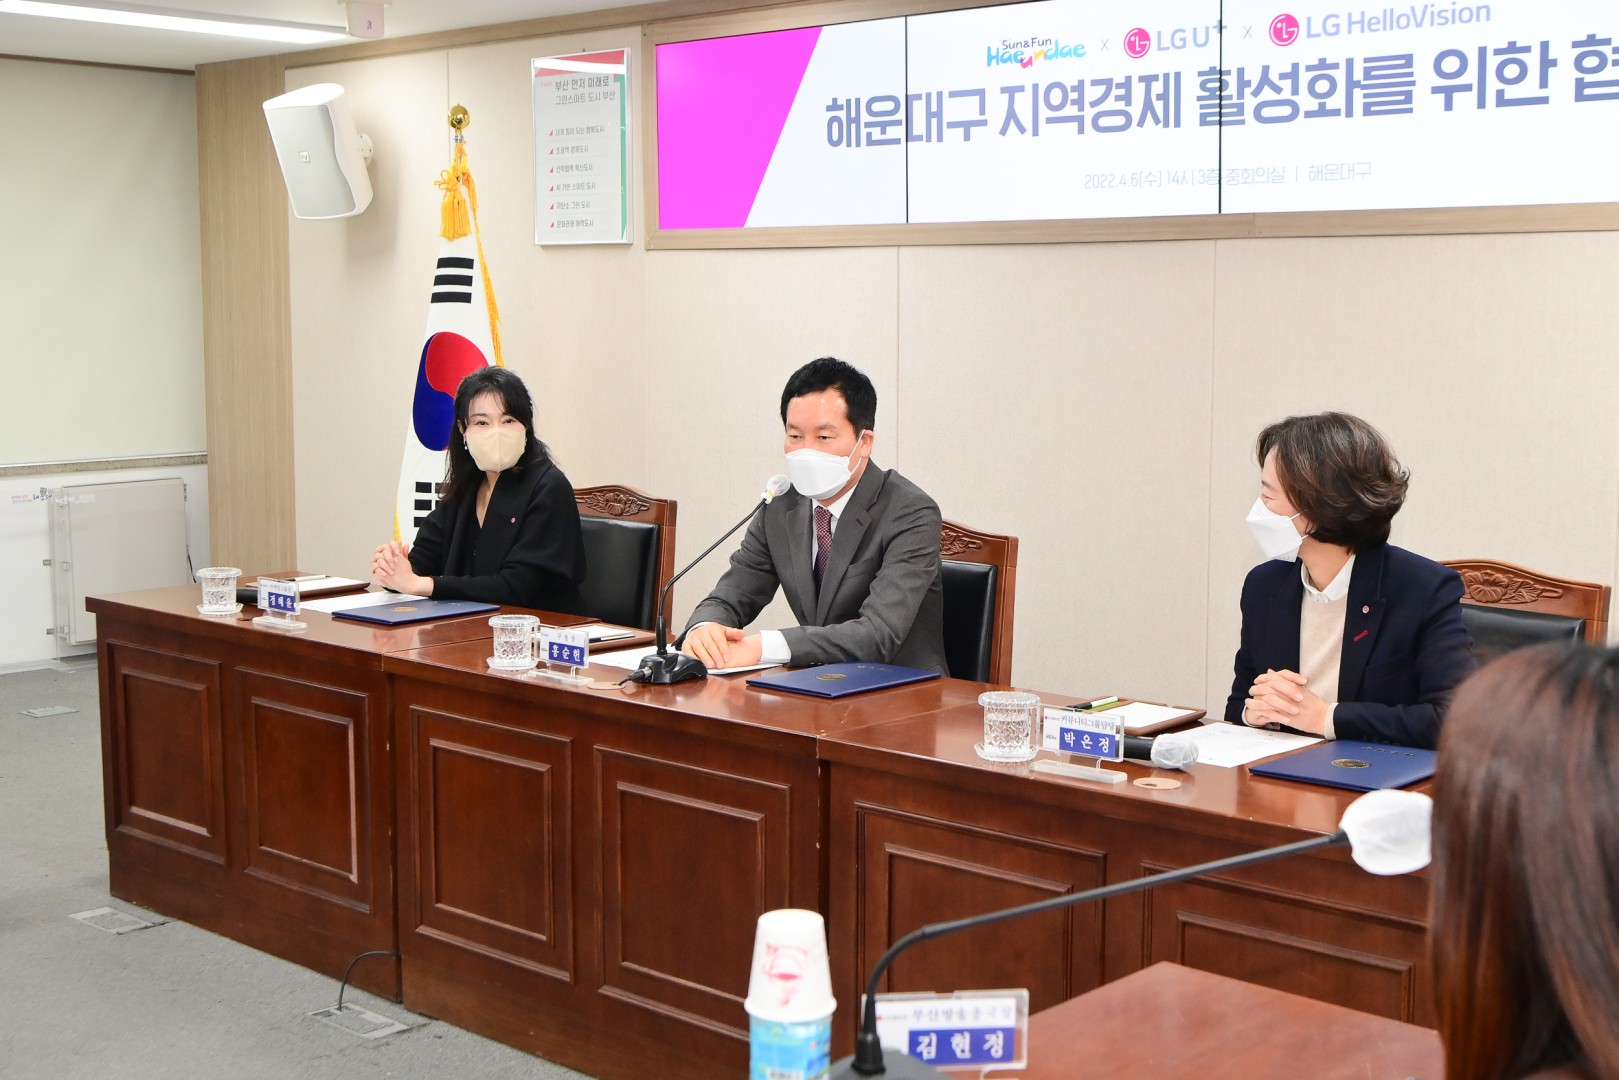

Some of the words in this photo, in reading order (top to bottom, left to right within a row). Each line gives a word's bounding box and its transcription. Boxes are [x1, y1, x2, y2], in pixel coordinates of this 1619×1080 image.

[1307, 14, 1341, 38] LG
[1348, 2, 1491, 34] HelloVision
[1002, 37, 1052, 50] Sun&Fun
[1157, 28, 1187, 51] LG
[987, 39, 1087, 68] Haeundae
[826, 88, 988, 147] 해운대구
[999, 71, 1181, 137] 지역경제
[1195, 53, 1416, 127] 활성화를
[1431, 40, 1557, 111] 위한
[1226, 166, 1286, 185] 중회의실
[1308, 162, 1372, 182] 해운대구
[1063, 731, 1110, 753] 박은정
